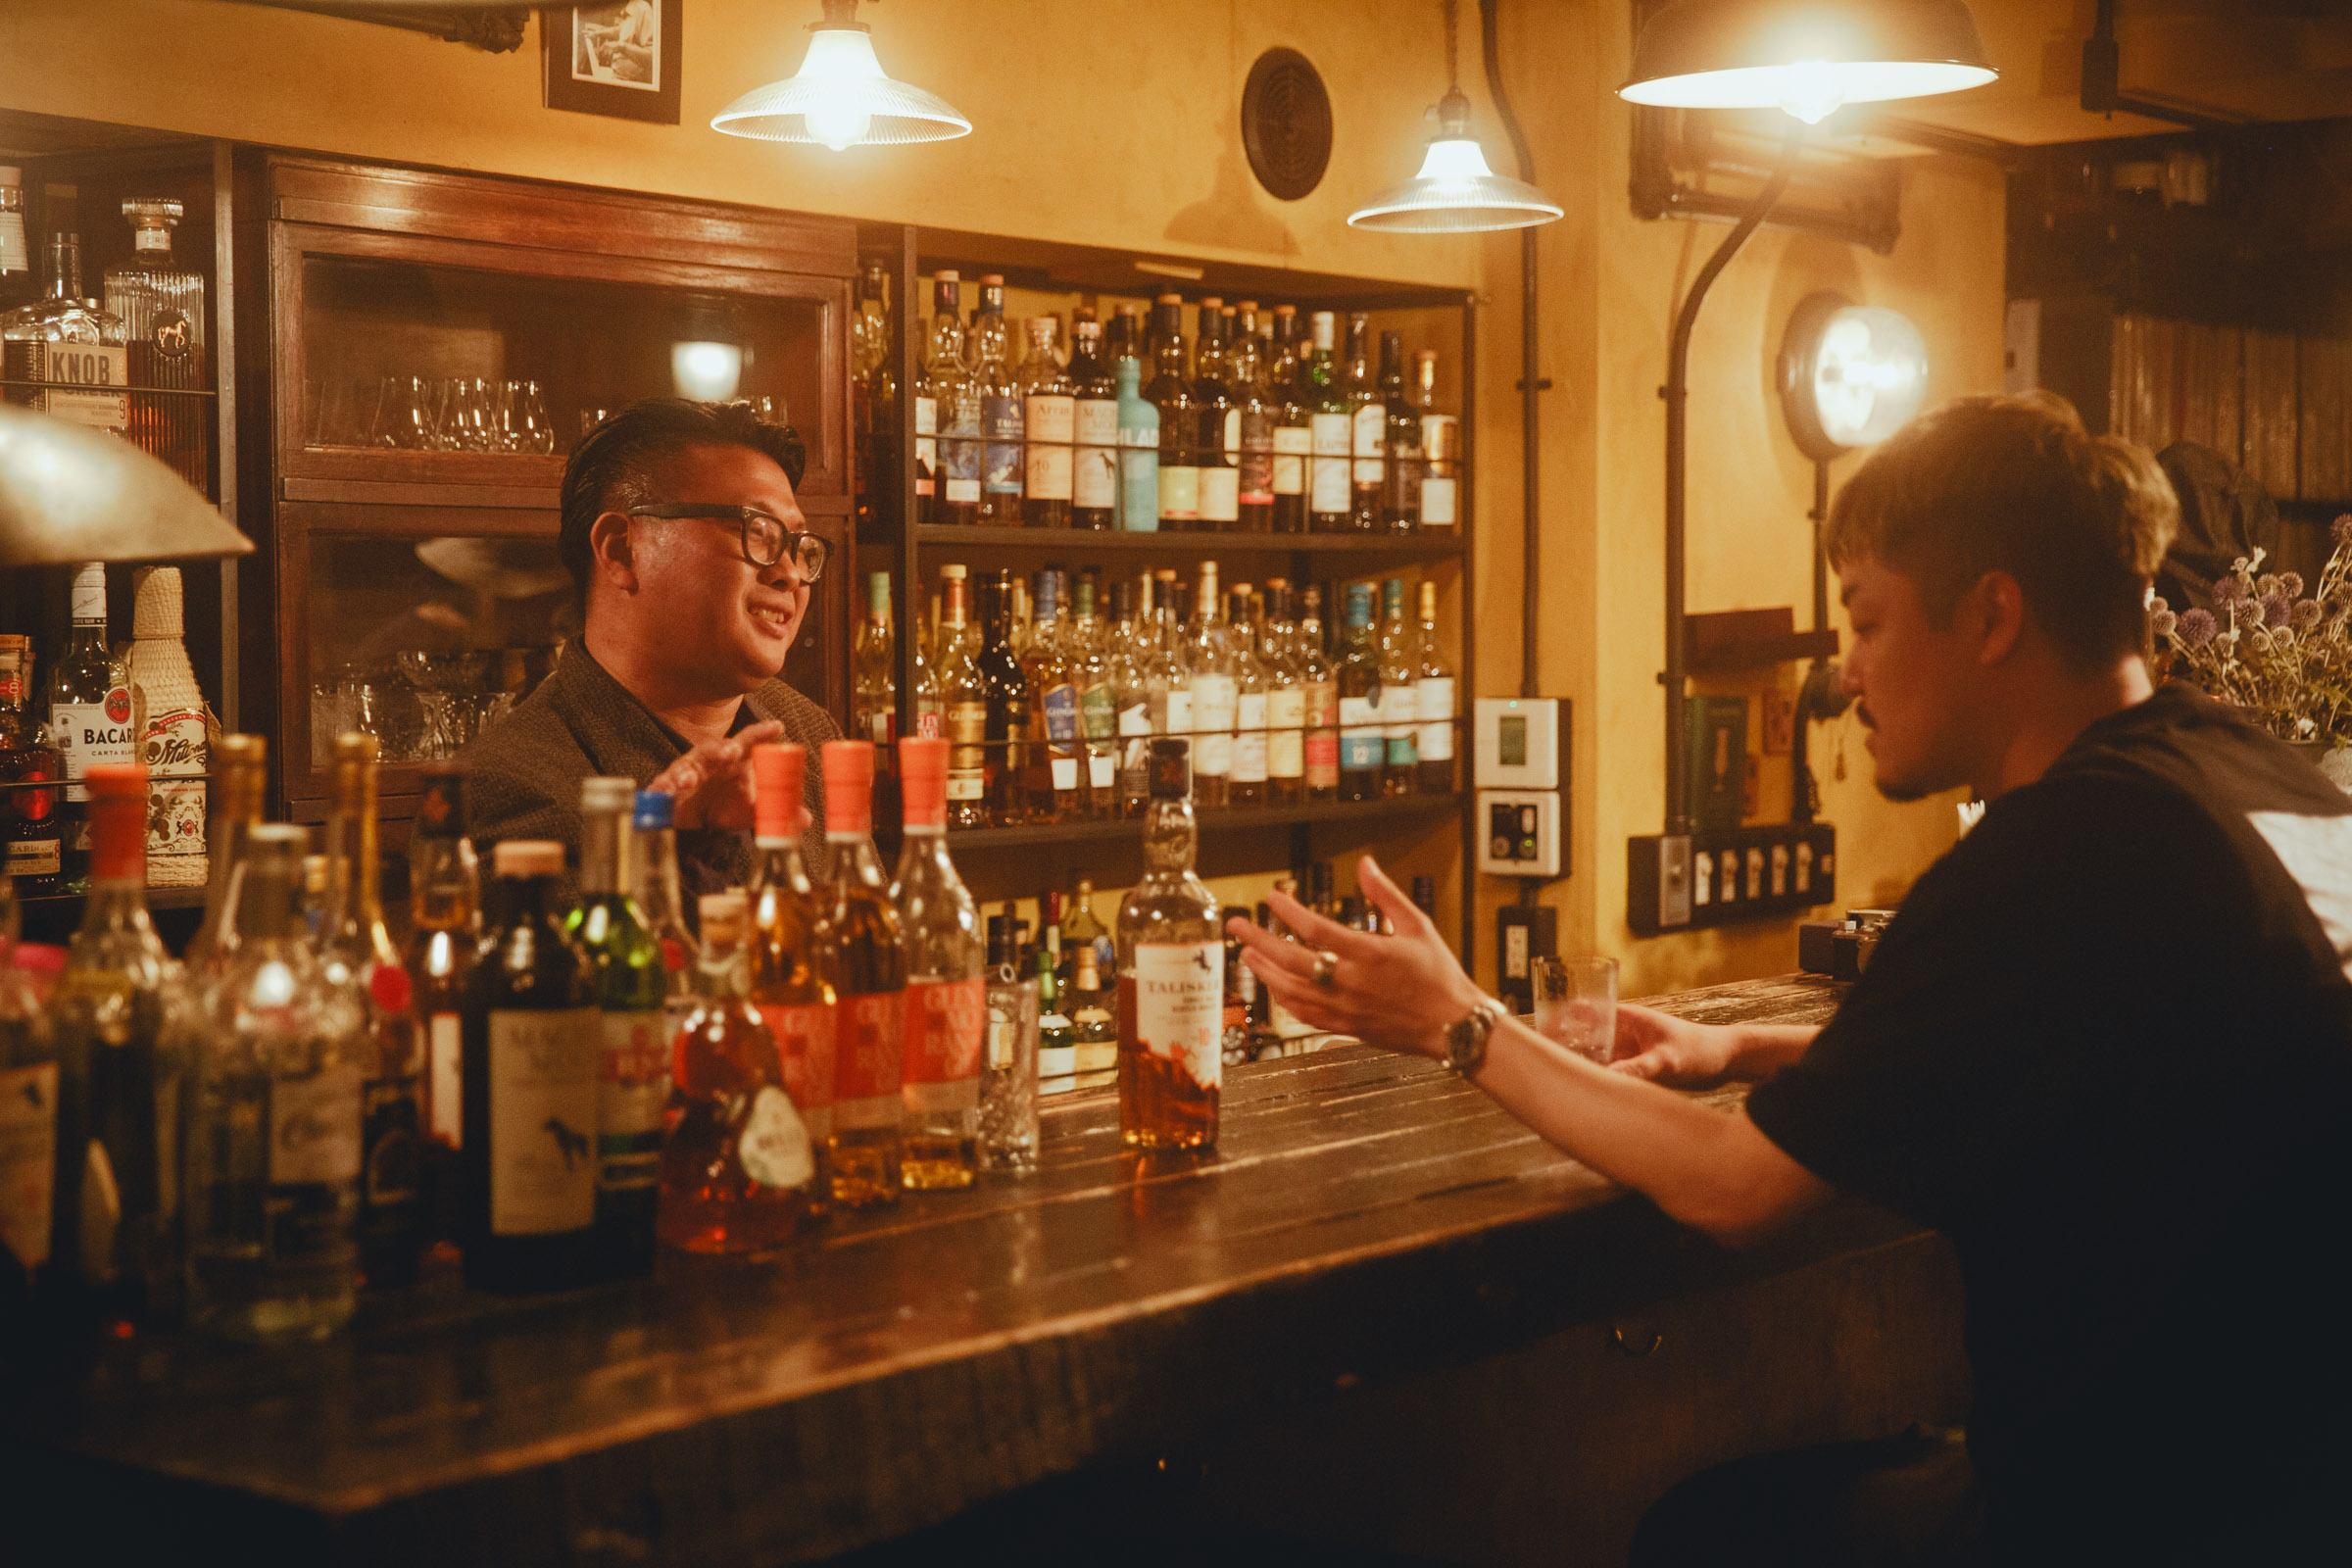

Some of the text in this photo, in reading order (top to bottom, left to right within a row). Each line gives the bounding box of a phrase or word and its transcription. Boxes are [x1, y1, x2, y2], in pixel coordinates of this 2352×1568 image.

[52, 352, 110, 385] KNOB
[119, 399, 125, 419] 9
[84, 728, 135, 745] BACAR
